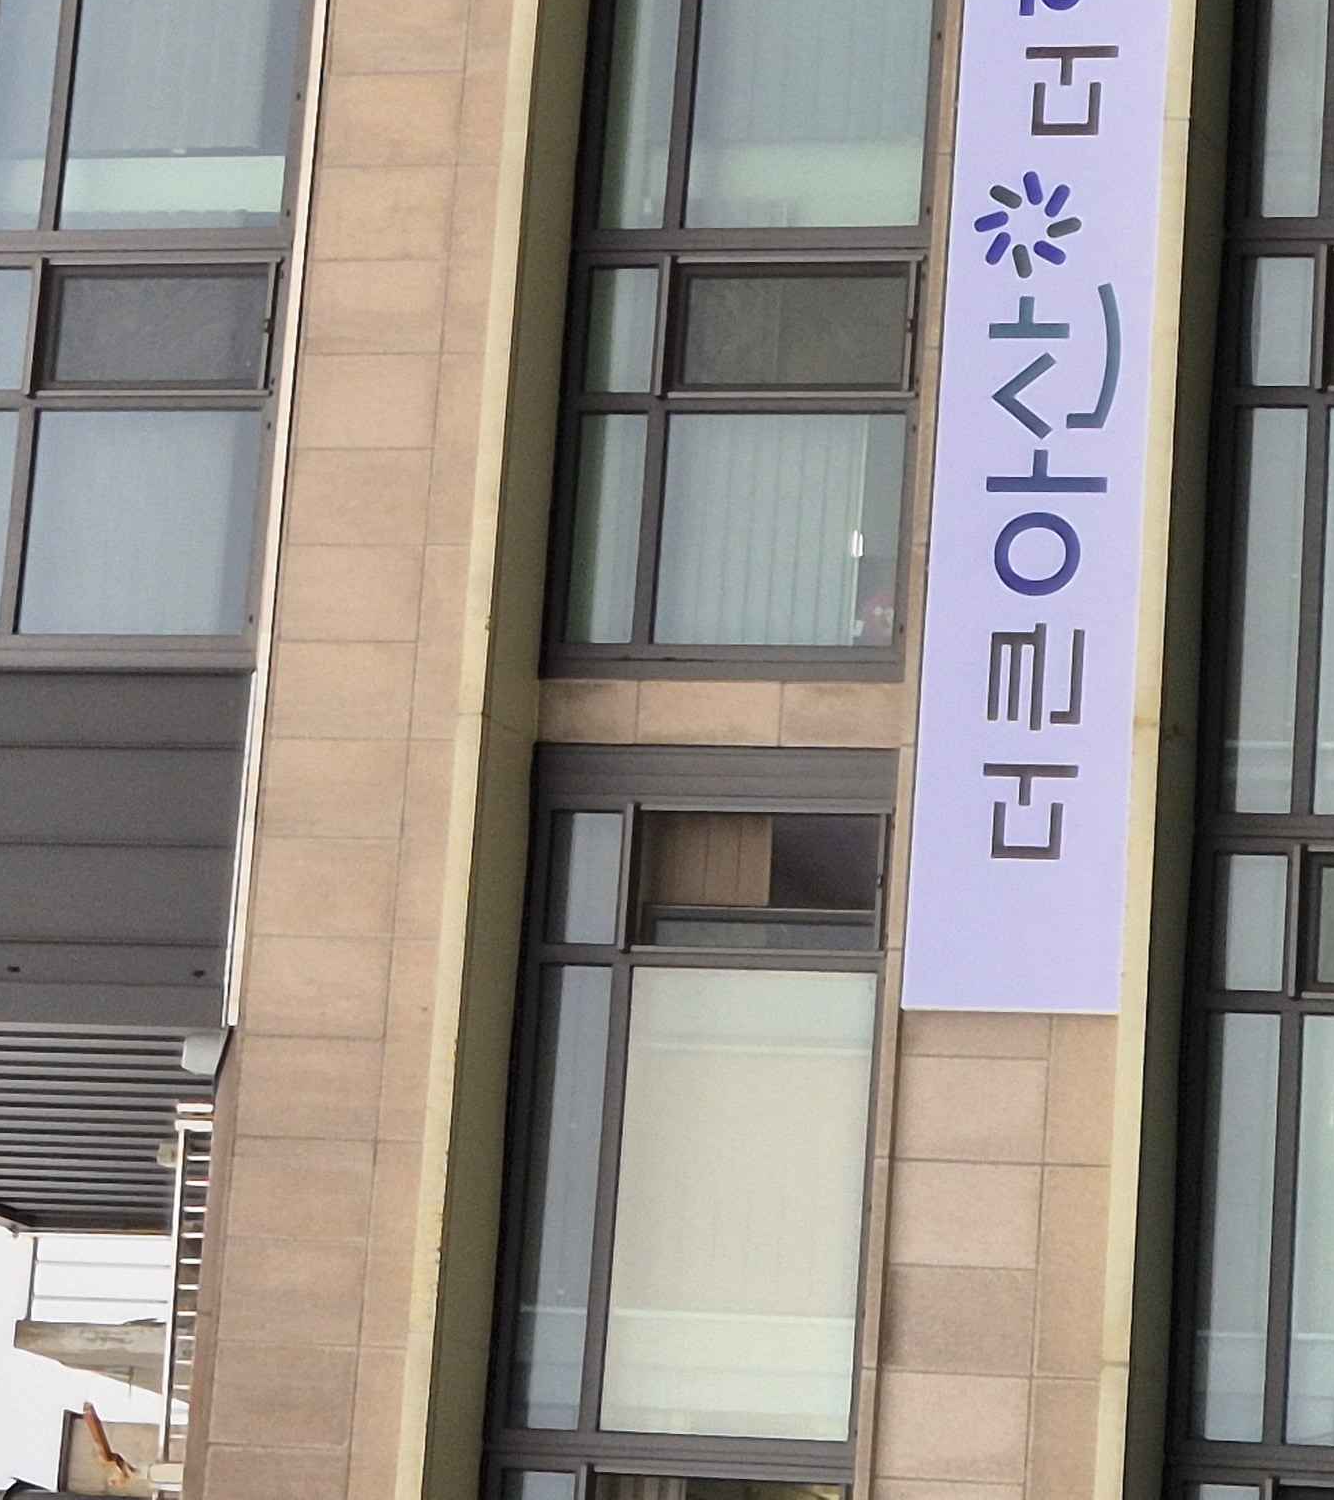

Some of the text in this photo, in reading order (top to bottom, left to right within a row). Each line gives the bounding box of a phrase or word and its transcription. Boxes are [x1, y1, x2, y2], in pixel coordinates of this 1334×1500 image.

[1025, 45, 1120, 137] 더
[985, 283, 1121, 597] 아산
[986, 622, 1086, 732] 큰
[982, 762, 1080, 861] 더
